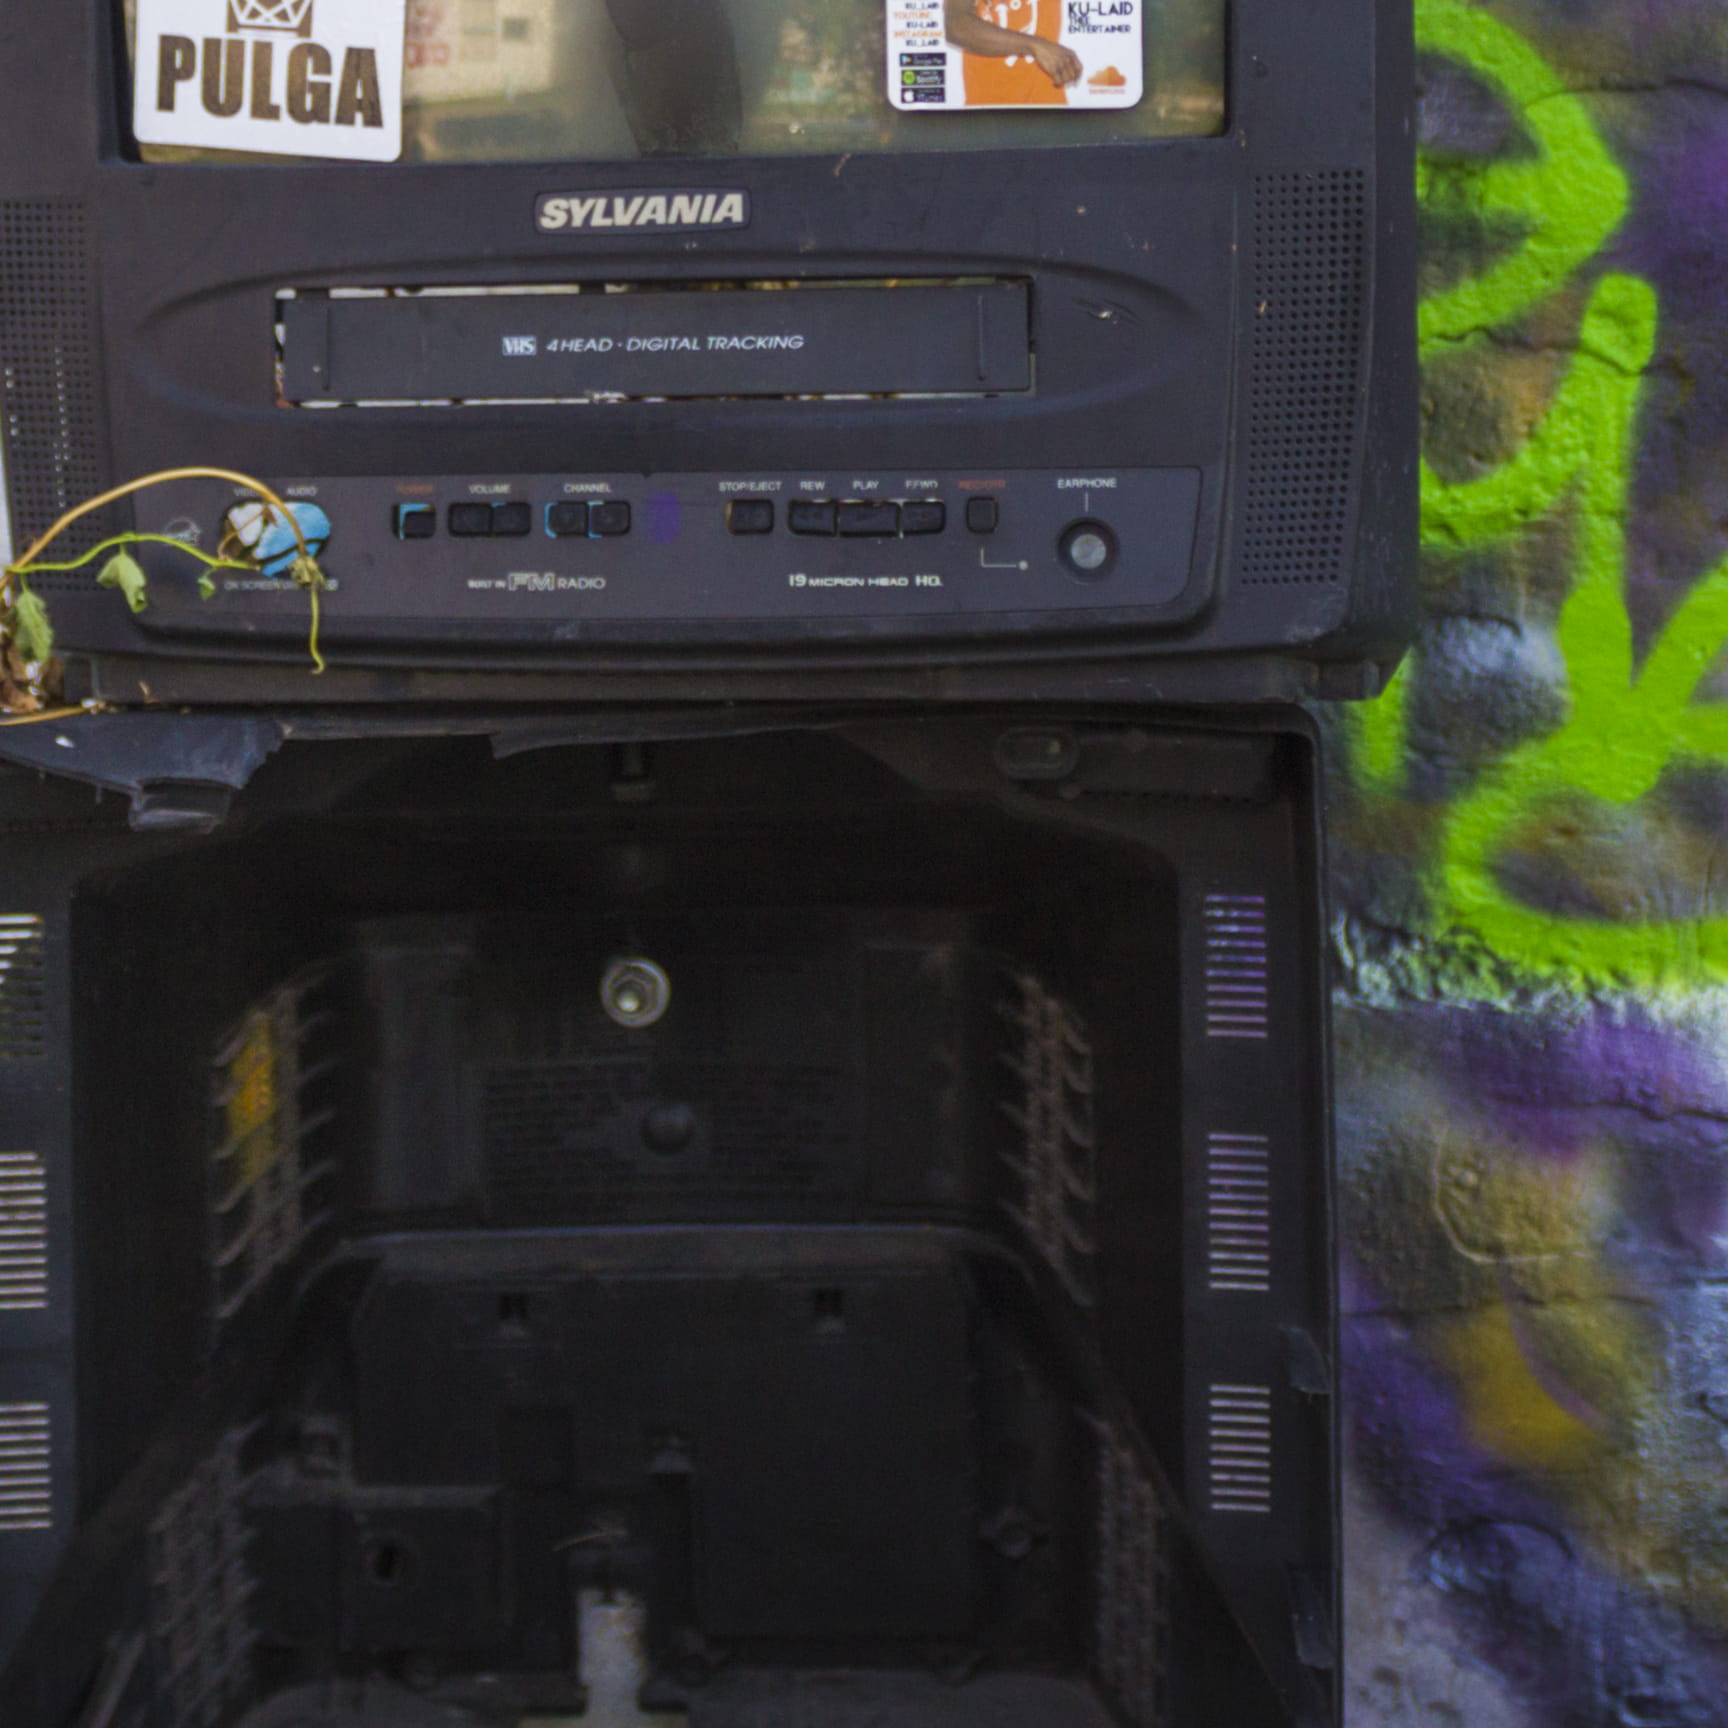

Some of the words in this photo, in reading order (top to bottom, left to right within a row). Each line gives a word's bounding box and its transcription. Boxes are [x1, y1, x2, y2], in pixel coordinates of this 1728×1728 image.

[1068, 1, 1133, 17] KU-LAID
[156, 34, 384, 129] PULGA
[540, 193, 744, 229] SYLVANIA
[503, 336, 536, 356] VHS
[626, 335, 700, 351] DIGITAL
[706, 334, 804, 350] TRACKING
[469, 484, 511, 494] VOLUME
[563, 482, 612, 493] CHANNEL
[799, 481, 825, 491] REW
[852, 480, 879, 490] PLAY
[1057, 477, 1117, 488] EARPHONE
[286, 486, 317, 496] AUDIO
[508, 572, 555, 591] FM
[557, 576, 607, 589] RADIO
[789, 574, 807, 587] 19
[808, 576, 865, 587] MICRON
[867, 576, 909, 587] HEAD
